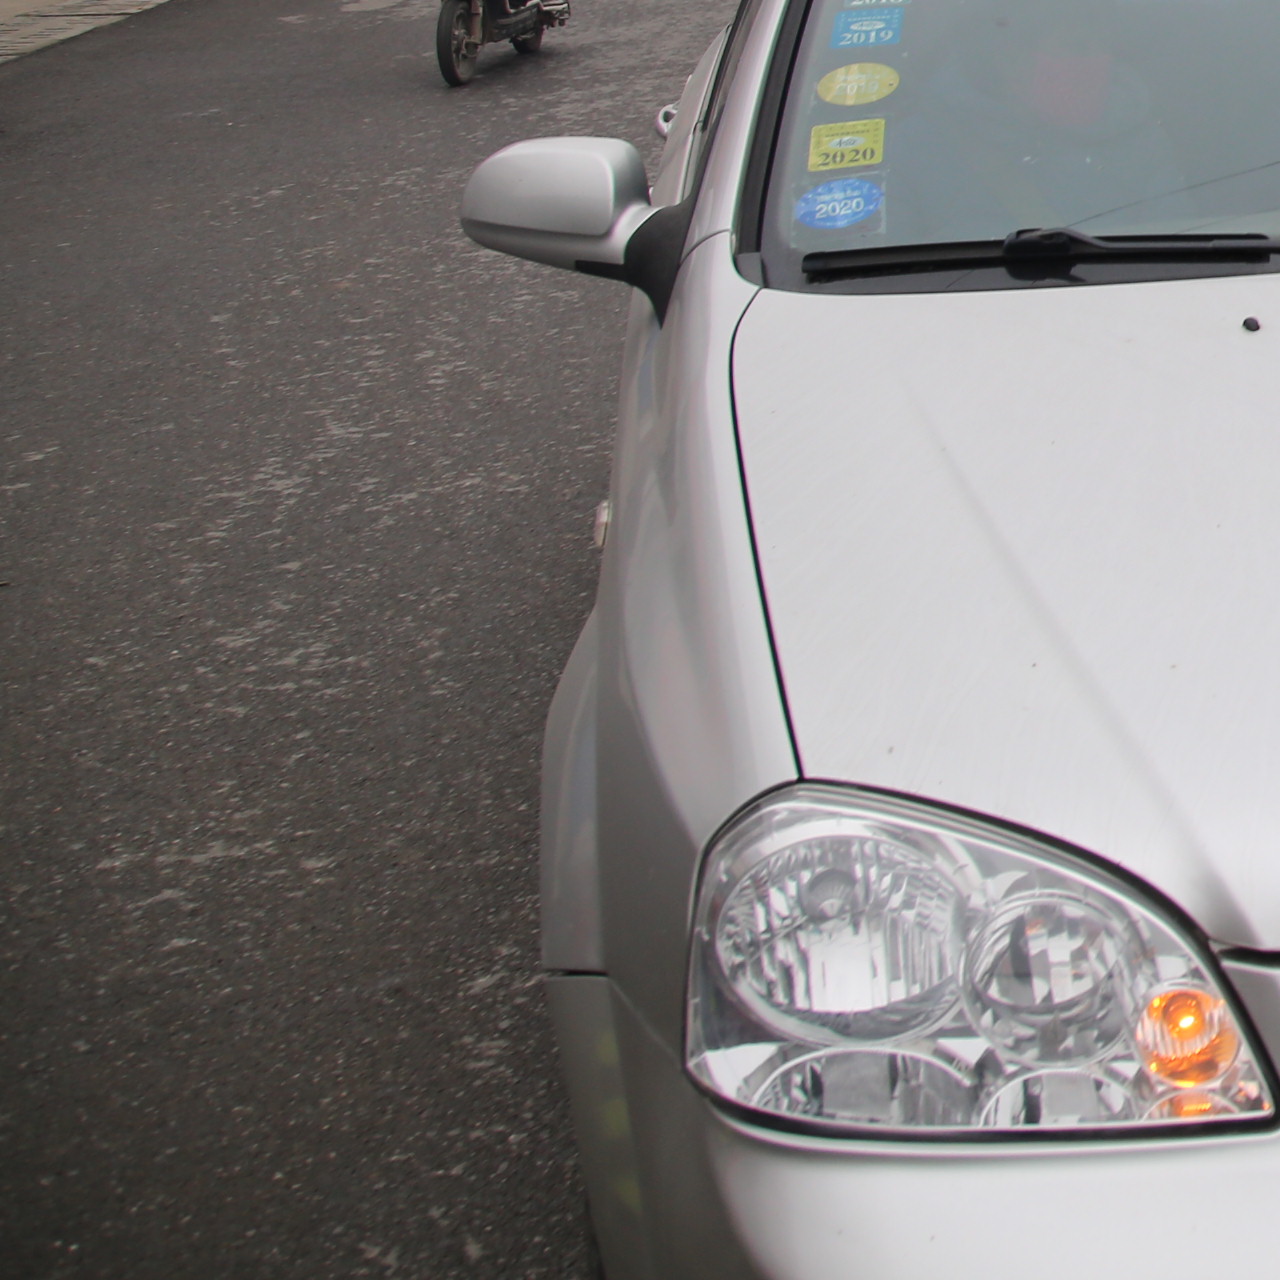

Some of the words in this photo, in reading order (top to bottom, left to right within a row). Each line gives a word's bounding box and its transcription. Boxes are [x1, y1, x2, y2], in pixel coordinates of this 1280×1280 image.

[839, 30, 894, 45] 2019
[817, 147, 875, 167] 2020
[815, 196, 865, 219] 2020
